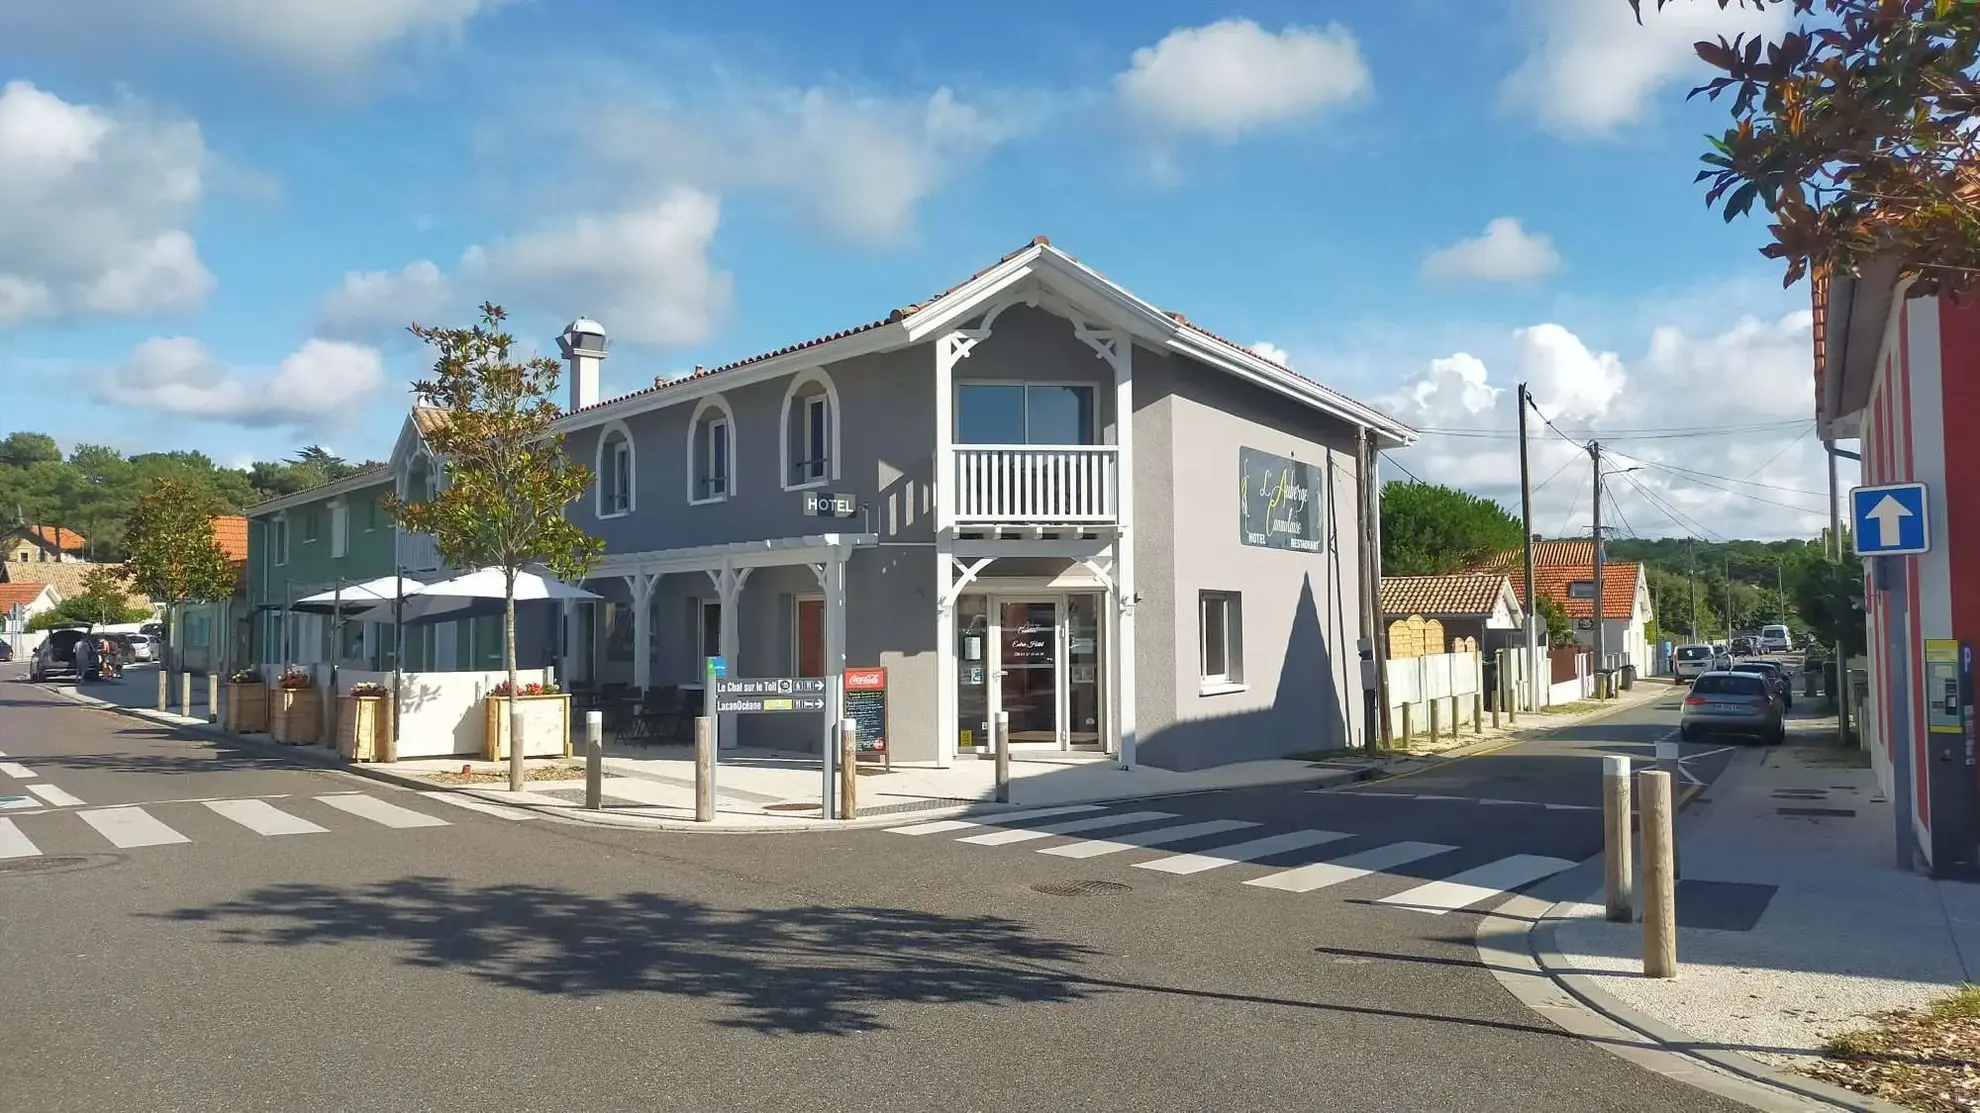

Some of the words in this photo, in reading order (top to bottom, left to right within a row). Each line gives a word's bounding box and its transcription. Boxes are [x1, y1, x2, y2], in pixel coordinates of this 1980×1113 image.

[808, 498, 854, 513] HOTEL
[1290, 538, 1320, 550] RESTAURANT
[1963, 647, 1971, 673] P
[717, 682, 726, 693] Le
[727, 681, 743, 693] Chat
[744, 683, 755, 692] sur
[756, 681, 763, 692] le
[764, 681, 777, 692] Toit
[717, 699, 762, 711] LacanOcéane
